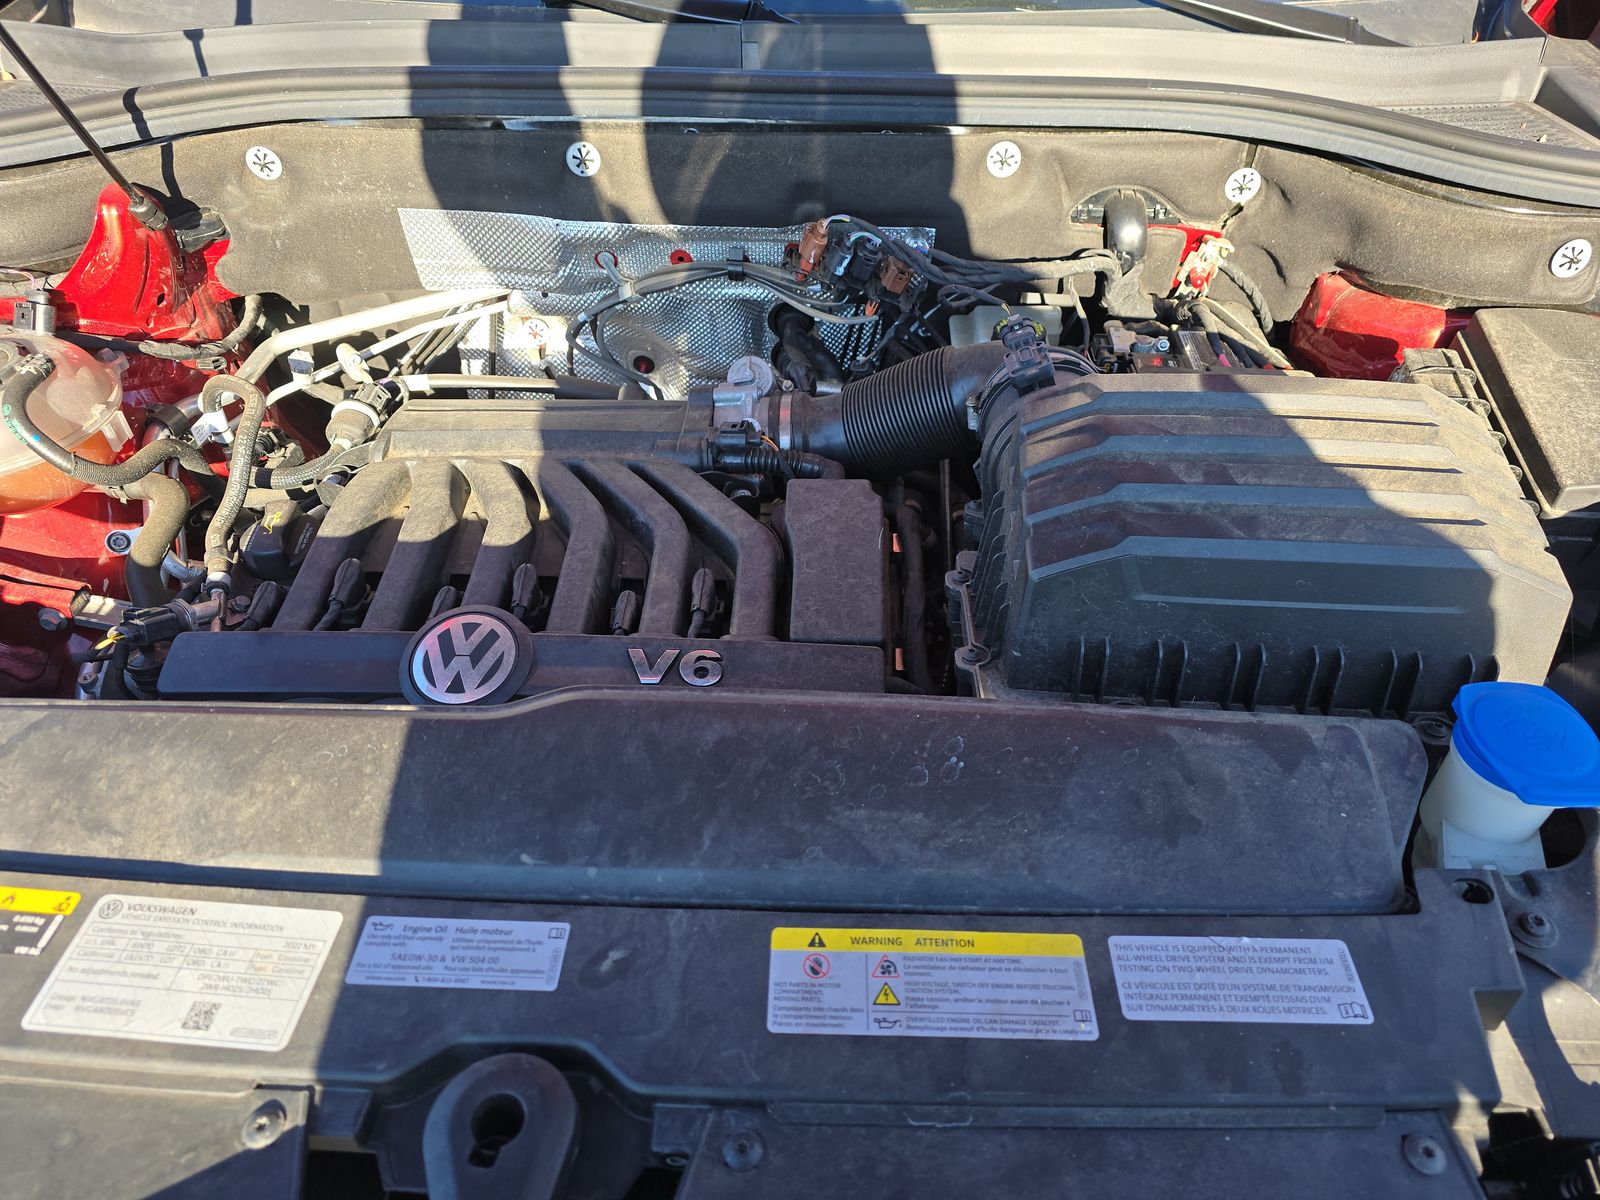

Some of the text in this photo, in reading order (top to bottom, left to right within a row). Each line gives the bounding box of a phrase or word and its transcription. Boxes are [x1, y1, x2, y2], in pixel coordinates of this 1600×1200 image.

[628, 648, 723, 686] V6
[127, 903, 197, 915] VOLKSWAGEN
[153, 914, 190, 924] EMISSION
[191, 918, 228, 927] CONTROL
[229, 920, 285, 932] INFORMATION
[402, 924, 449, 935] Engine Oil
[455, 925, 514, 936] Huile moteur
[850, 936, 976, 948] WARNING ATTENTION
[1114, 943, 1135, 952] THIS
[1135, 943, 1172, 952] VEHICLE
[1172, 944, 1180, 952] IS
[1181, 944, 1226, 954] EQUIPPED
[1226, 945, 1250, 953] WITH
[1260, 945, 1312, 954] PERMANENT
[452, 955, 500, 965] VW 504 00
[1116, 953, 1164, 962] ALL-WHEEL
[1166, 954, 1192, 963] DRIVE
[1192, 955, 1226, 963] SYSTEM
[1226, 955, 1247, 964] AND
[1248, 956, 1258, 964] IS
[1259, 956, 1291, 965] EXEMPT
[1293, 957, 1320, 965] FROM
[1118, 964, 1155, 973] TESTING
[1155, 965, 1171, 973] ON
[1172, 965, 1226, 974] TWO-WHEEL
[1228, 966, 1255, 974] DRIVE
[1121, 981, 1134, 989] CE
[1134, 980, 1177, 990] VÉHICULE
[1177, 982, 1194, 991] EST
[1218, 982, 1241, 991] D'UN
[1242, 982, 1278, 992] SYSTÈME
[1279, 983, 1290, 992] DE
[1291, 984, 1356, 993] TRANSMISSION
[1123, 991, 1170, 1001] INTÉGRALE
[1170, 993, 1221, 1002] PERMANENT
[1222, 994, 1232, 1002] ET
[1272, 995, 1309, 1004] D'ESSAIS
[1125, 1003, 1145, 1012] SUR
[1145, 1002, 1217, 1013] DYNAMOMÈTRES
[1226, 1005, 1251, 1013] DEUX
[1252, 1005, 1282, 1014] ROUES
[1282, 1005, 1329, 1015] MOTRICES.
